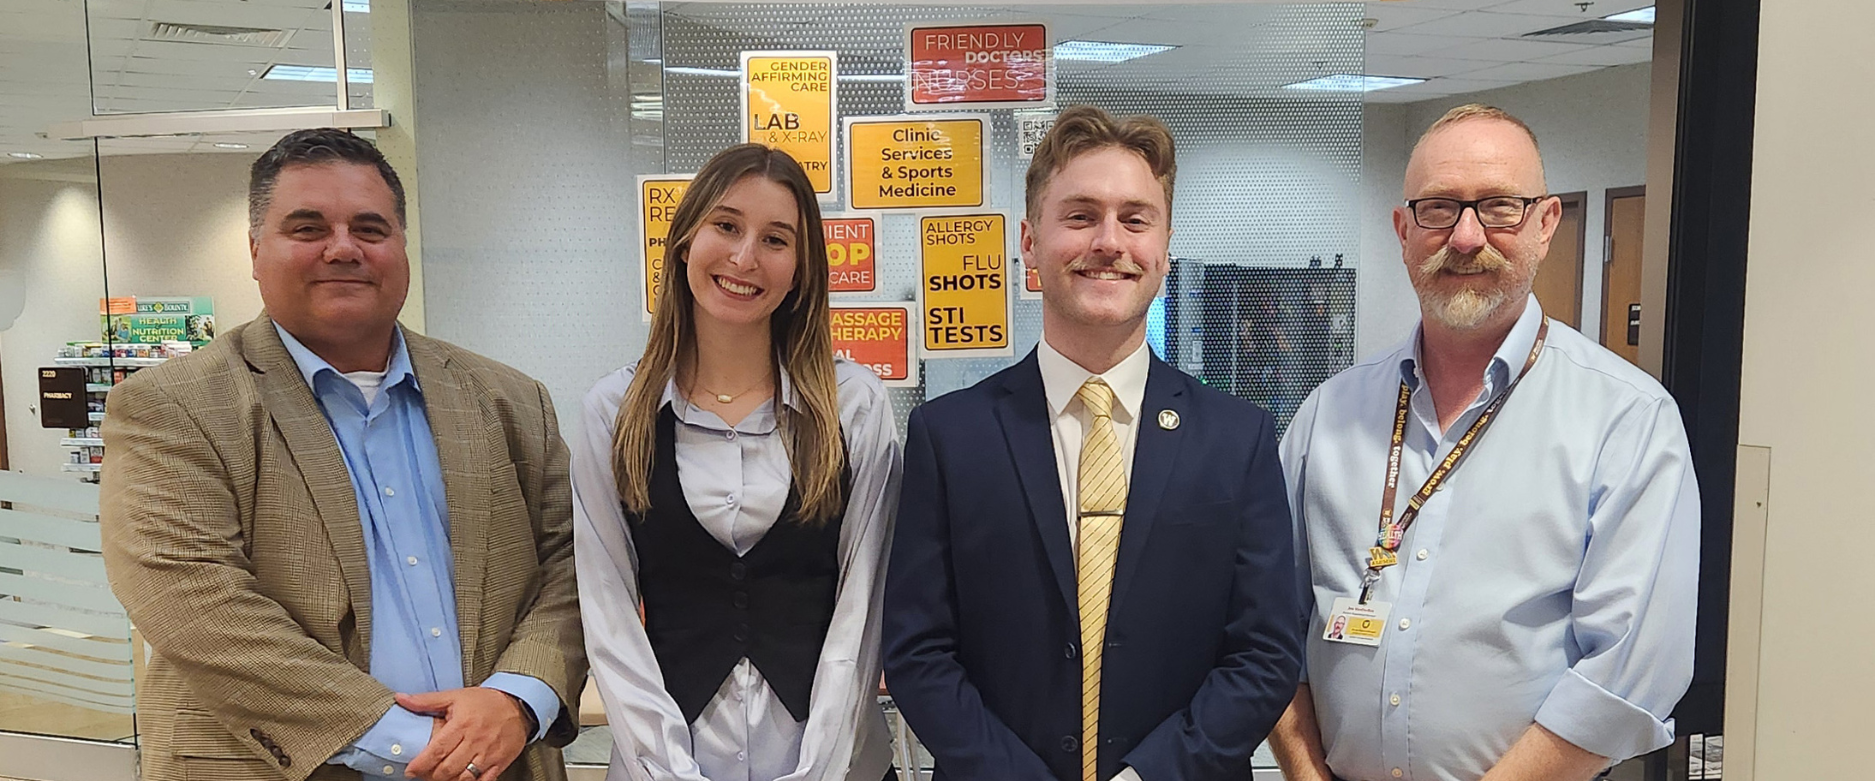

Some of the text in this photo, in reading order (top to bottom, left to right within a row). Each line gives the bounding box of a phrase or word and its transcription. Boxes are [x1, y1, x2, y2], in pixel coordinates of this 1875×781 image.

[925, 32, 1025, 51] FRIENDLY
[965, 49, 1043, 64] DOCTORS
[770, 61, 828, 71] GENDER
[751, 72, 828, 82] AFFIRMING
[790, 82, 828, 92] CARE
[753, 113, 800, 131] LAB
[768, 131, 828, 143] & X-RAY
[892, 129, 941, 142] Clinic
[881, 147, 953, 161] Services
[797, 160, 828, 171] ATRY
[881, 165, 953, 182] & Sports
[649, 187, 676, 204] RX
[879, 183, 957, 198] Medicine
[650, 206, 676, 222] RE
[825, 223, 870, 240] IENT
[926, 219, 994, 234] ALLERGY
[926, 233, 976, 246] SHOTS
[826, 242, 871, 266] OP
[963, 254, 1002, 271] FLU
[829, 271, 871, 285] CARE
[929, 273, 1002, 292] SHOTS
[139, 317, 177, 325] HEALTH
[831, 312, 902, 326] ASSAGE
[929, 307, 964, 325] STI
[132, 327, 184, 336] NUTRITION
[139, 335, 178, 343] CENTER
[830, 327, 902, 341] HERAPY
[929, 325, 1004, 344] TESTS
[835, 349, 856, 361] AL
[1393, 408, 1408, 444] belong.
[1387, 445, 1402, 489] together
[1421, 468, 1447, 496] grow.
[1443, 446, 1464, 470] play.
